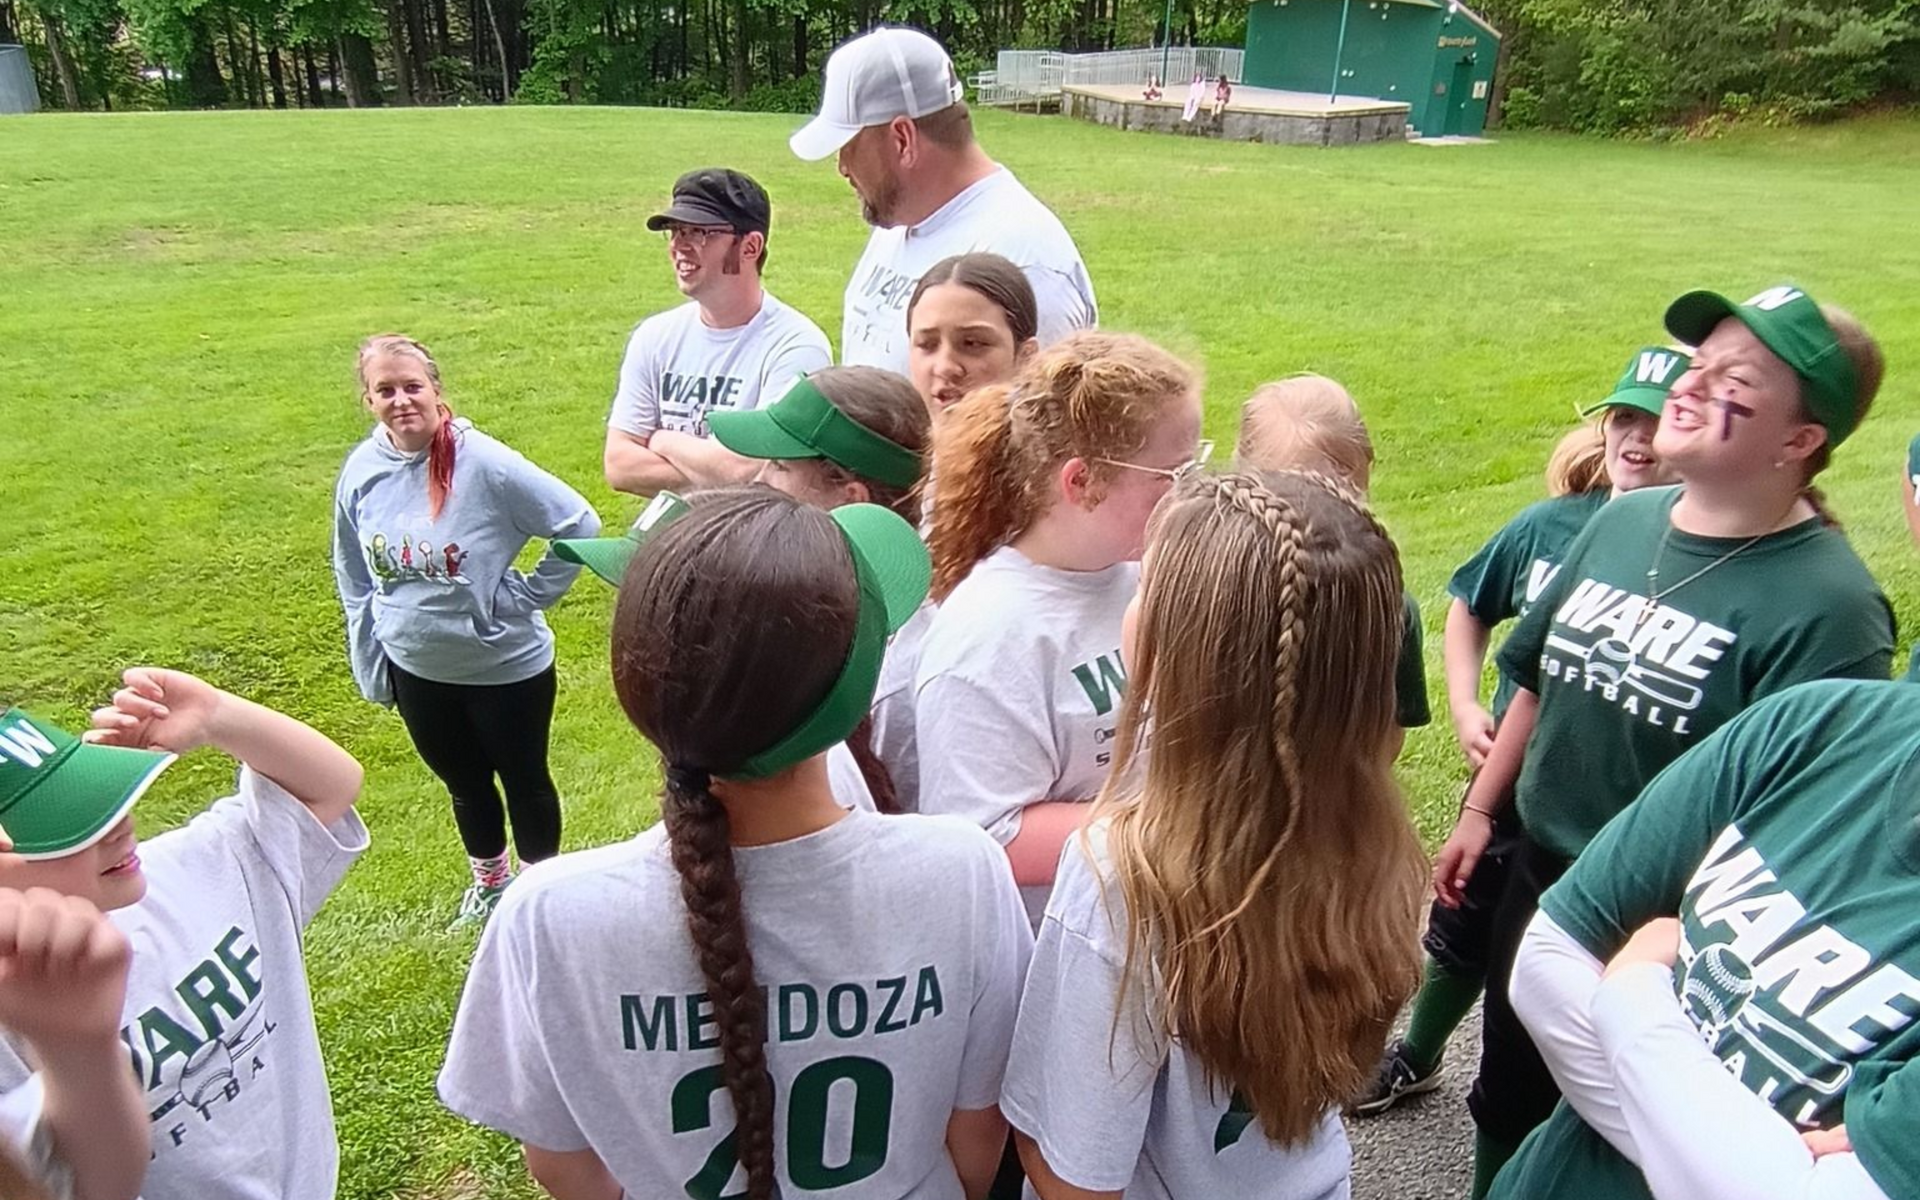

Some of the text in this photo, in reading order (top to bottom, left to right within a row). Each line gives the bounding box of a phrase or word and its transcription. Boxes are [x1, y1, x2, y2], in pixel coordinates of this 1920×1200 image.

[1740, 286, 1804, 311] W
[1636, 351, 1679, 384] W
[1555, 578, 1738, 680] WARE
[1540, 654, 1691, 735] SOFTBALL
[1685, 824, 1920, 1054] WARE
[671, 1055, 894, 1200] 20
